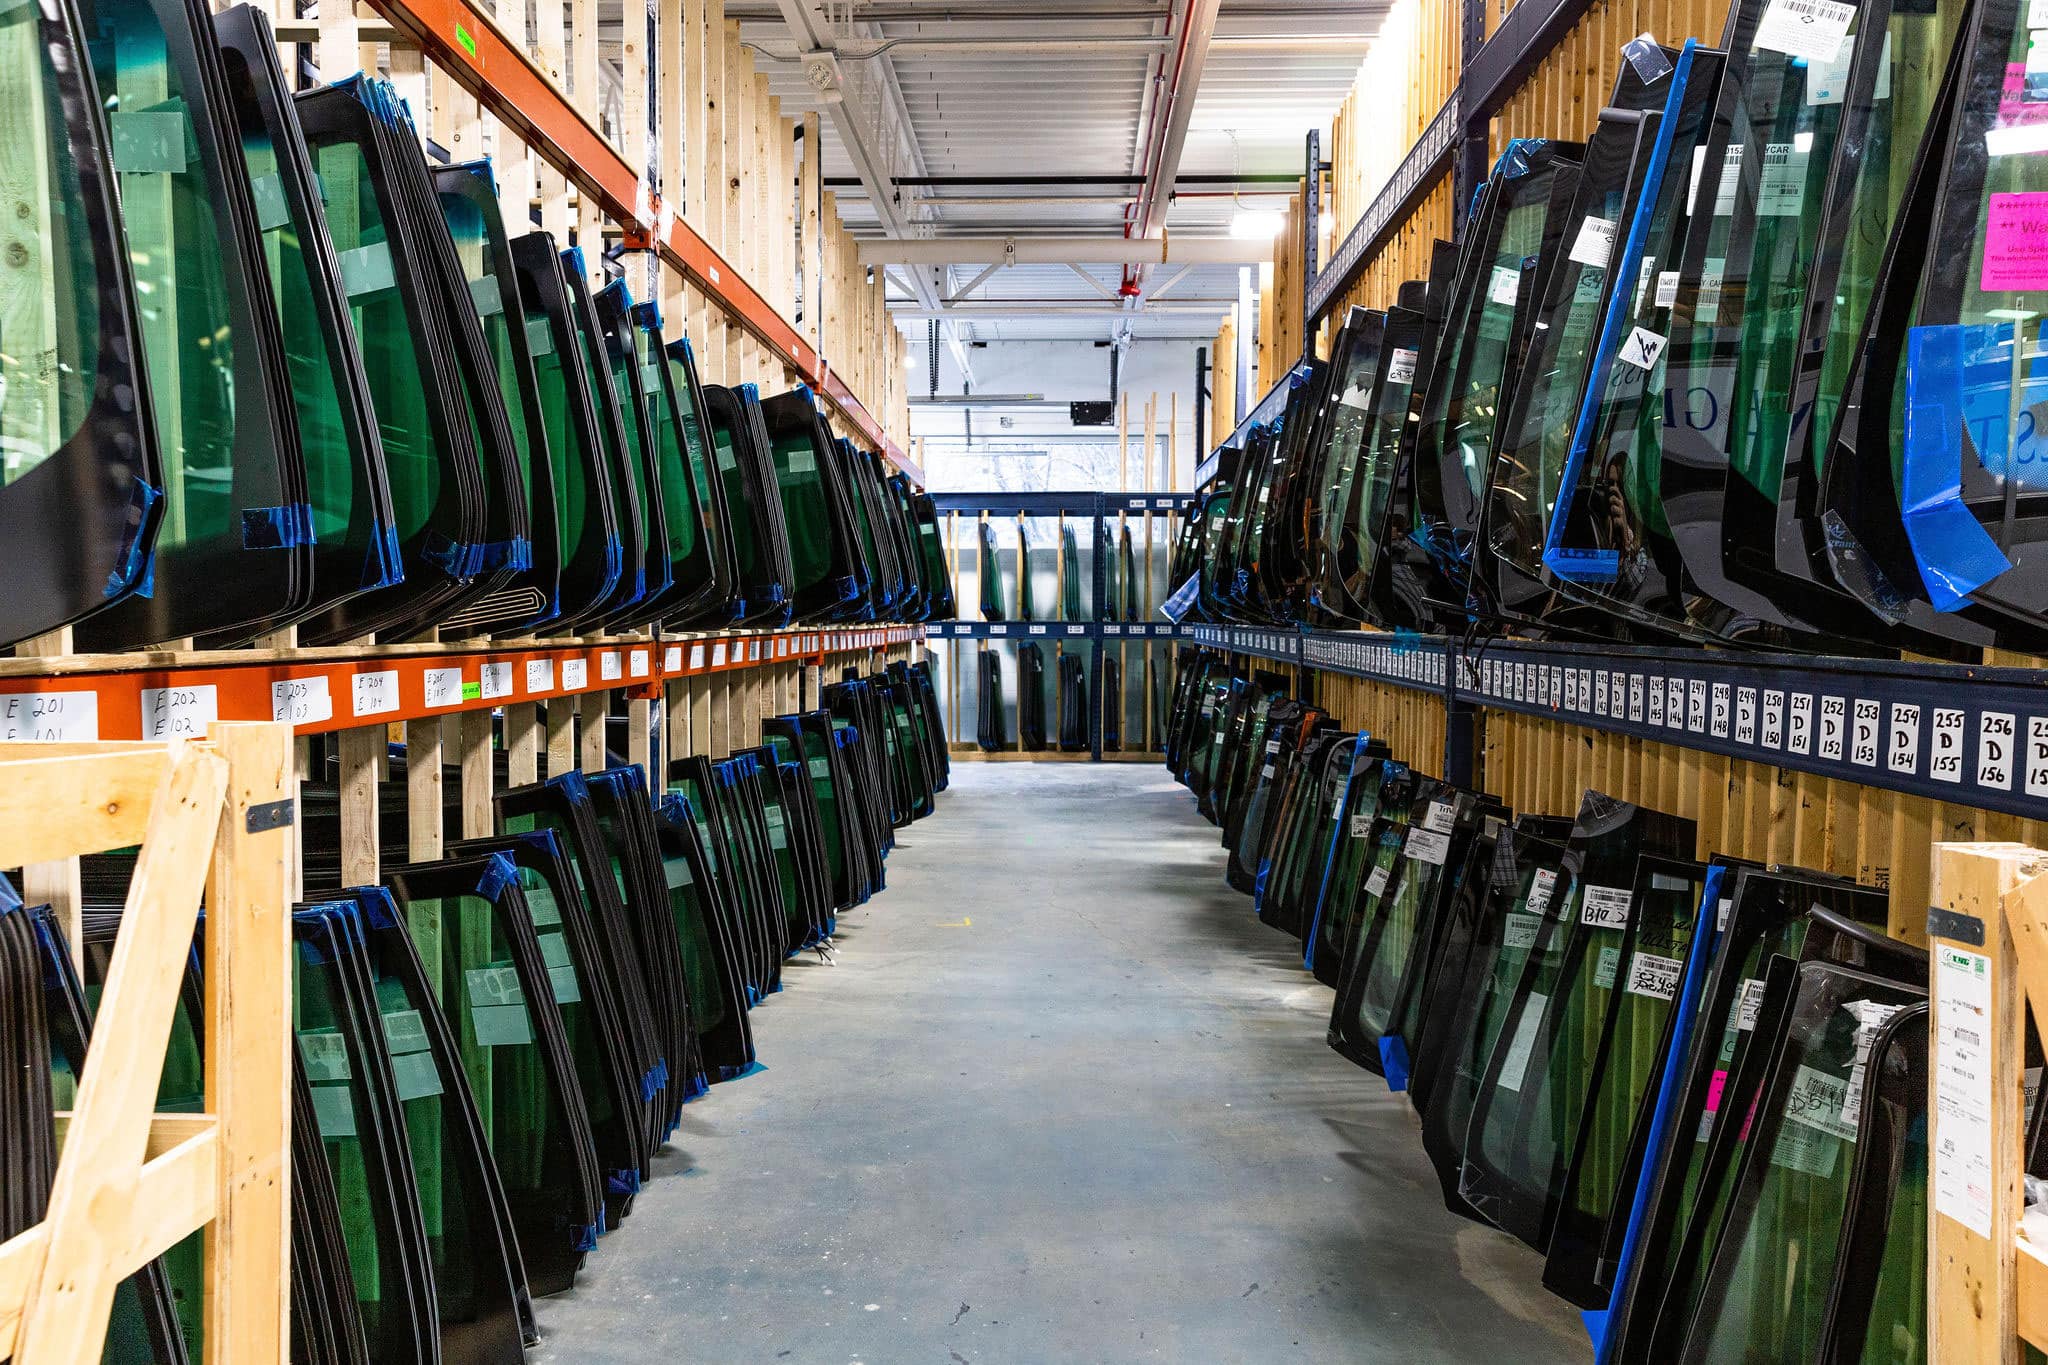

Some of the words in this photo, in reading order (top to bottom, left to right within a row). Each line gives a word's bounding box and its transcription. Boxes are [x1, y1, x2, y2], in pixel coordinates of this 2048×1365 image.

[358, 677, 365, 689] E
[1614, 676, 1624, 686] 243
[1651, 679, 1664, 691] 245
[1670, 681, 1683, 693] 246
[276, 683, 285, 699] E
[287, 683, 309, 702] 203
[1581, 686, 1586, 696] D
[1598, 688, 1604, 698] D
[1691, 682, 1705, 695] 247
[1714, 686, 1730, 700] 248
[154, 690, 167, 714] E
[171, 691, 198, 708] 202
[1614, 691, 1620, 702] D
[1633, 692, 1639, 701] D
[1653, 695, 1659, 705] D
[1671, 697, 1678, 708] D
[1739, 691, 1755, 705] 249
[1765, 694, 1782, 707] 250
[1793, 697, 1810, 710] 251
[7, 699, 19, 719] E
[33, 697, 64, 717] 201
[1613, 704, 1622, 715] 143
[1693, 700, 1700, 711] D
[1716, 704, 1725, 717] D
[1823, 700, 1844, 716] 252
[1856, 704, 1879, 720] 253
[276, 707, 285, 721] E
[1651, 708, 1662, 720] 145
[1670, 712, 1682, 723] 146
[1741, 709, 1749, 721] D
[1767, 713, 1777, 725] D
[1894, 708, 1919, 726] 254
[1936, 712, 1963, 728] 255
[154, 718, 165, 737] E
[170, 717, 195, 734] 102
[1689, 715, 1703, 729] 147
[1714, 720, 1727, 733] 148
[1793, 716, 1804, 729] D
[1825, 720, 1835, 735] D
[1983, 717, 2012, 736] 256
[1738, 726, 1752, 739] 149
[1765, 731, 1779, 745] 150
[1859, 725, 1871, 741] D
[1896, 731, 1909, 748] D
[1792, 736, 1807, 749] 151
[1823, 740, 1840, 755] 152
[1940, 733, 1953, 748] D
[1856, 746, 1874, 762] 153
[1986, 741, 2002, 761] D
[1892, 752, 1914, 768] 154
[1933, 756, 1961, 772] 155
[1980, 767, 2005, 783] 156
[2031, 769, 2048, 785] 15
